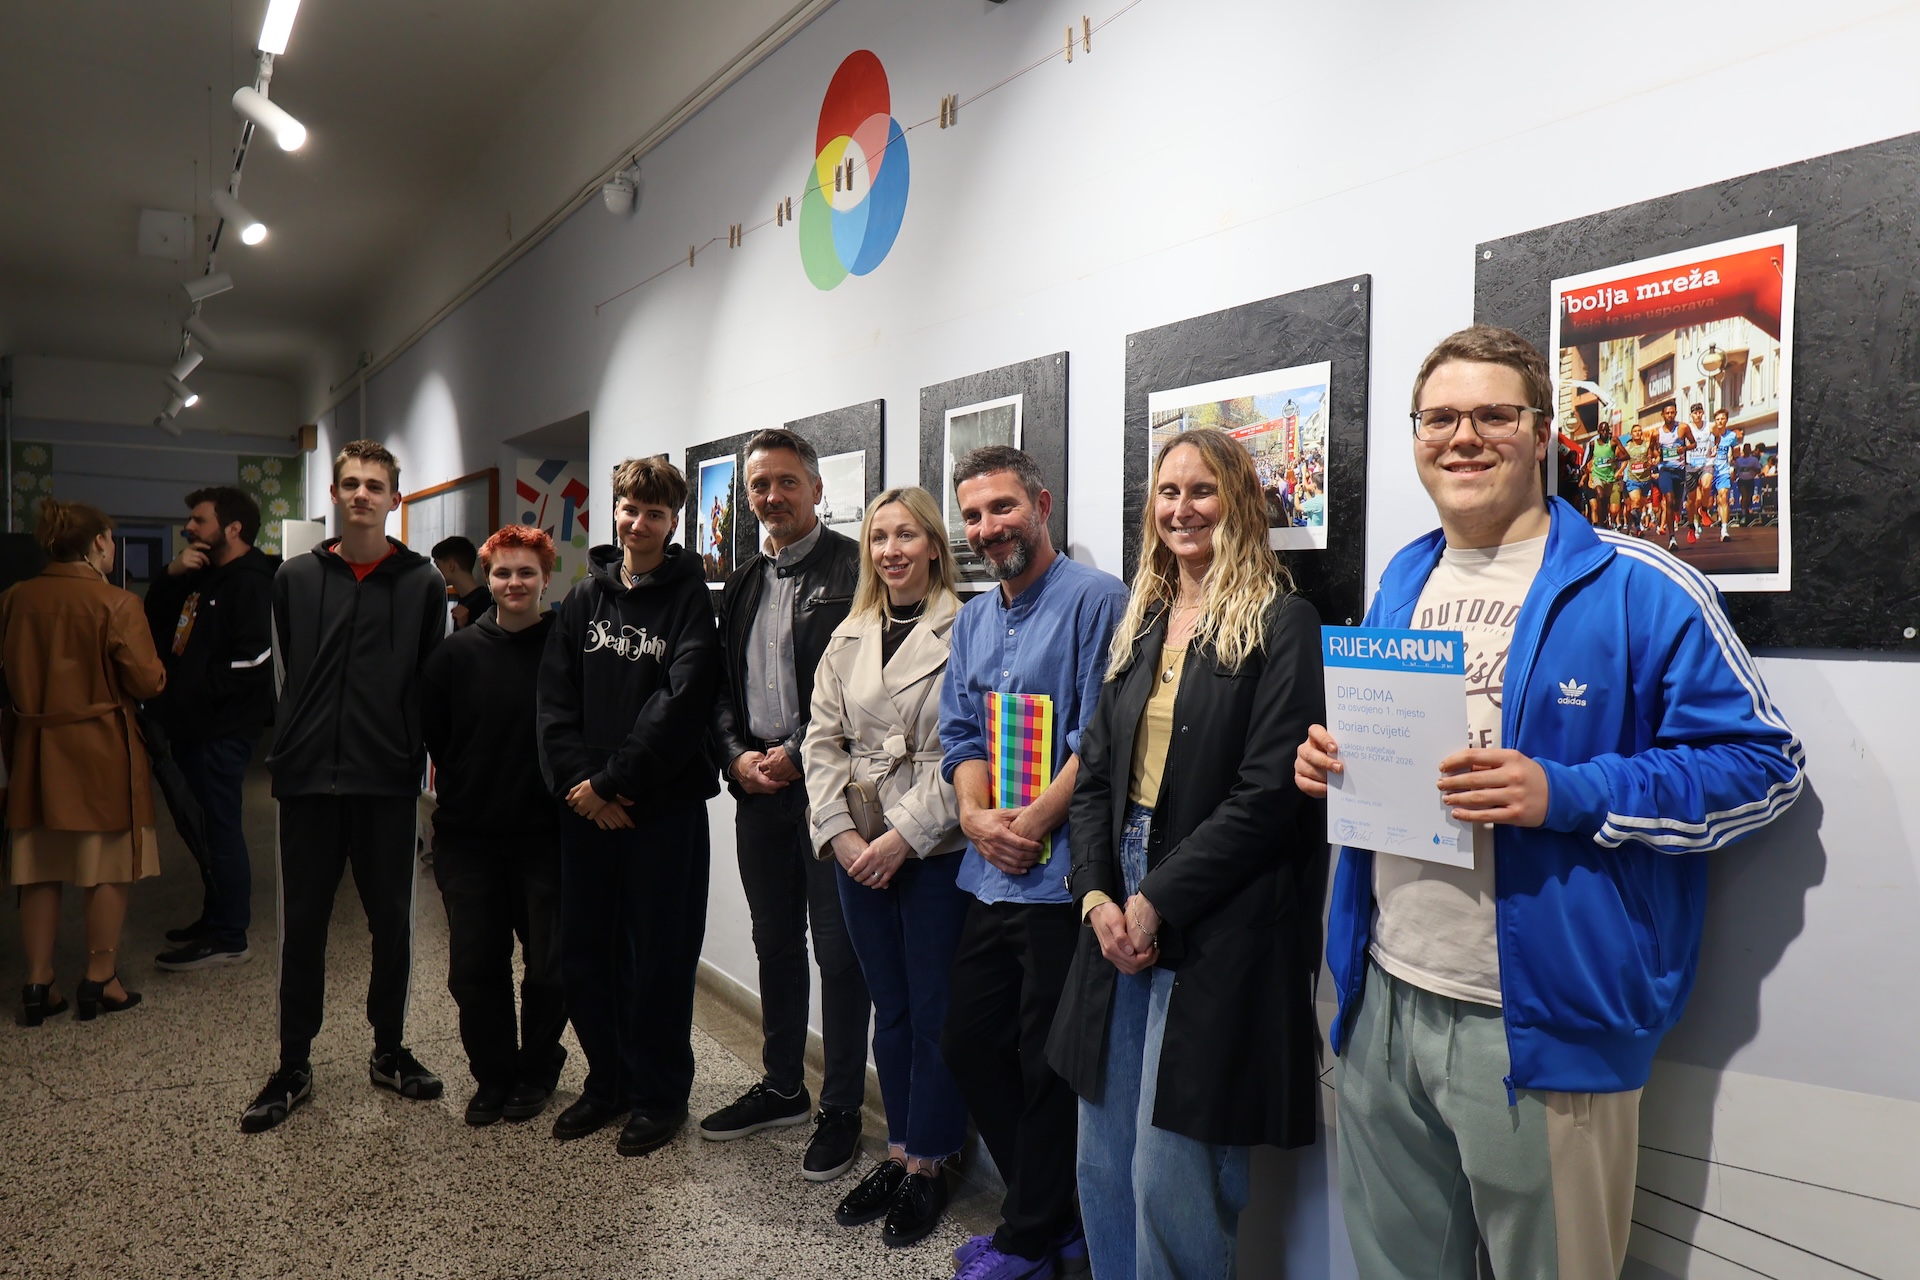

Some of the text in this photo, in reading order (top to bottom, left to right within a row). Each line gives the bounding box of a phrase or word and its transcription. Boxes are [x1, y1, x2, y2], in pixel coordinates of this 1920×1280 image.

[1636, 268, 1720, 300] mreža
[1624, 312, 1641, 322] ne
[584, 620, 630, 656] Sean
[1329, 636, 1454, 662] RIJEKARUN
[1337, 685, 1394, 703] DIPLOMA
[1557, 697, 1587, 707] adidas
[1337, 703, 1425, 719] za osvojeno 1. mjesto
[1338, 720, 1411, 739] Dorian Cvijetić
[1344, 743, 1365, 751] sklopu
[1368, 754, 1393, 763] FOTKAT
